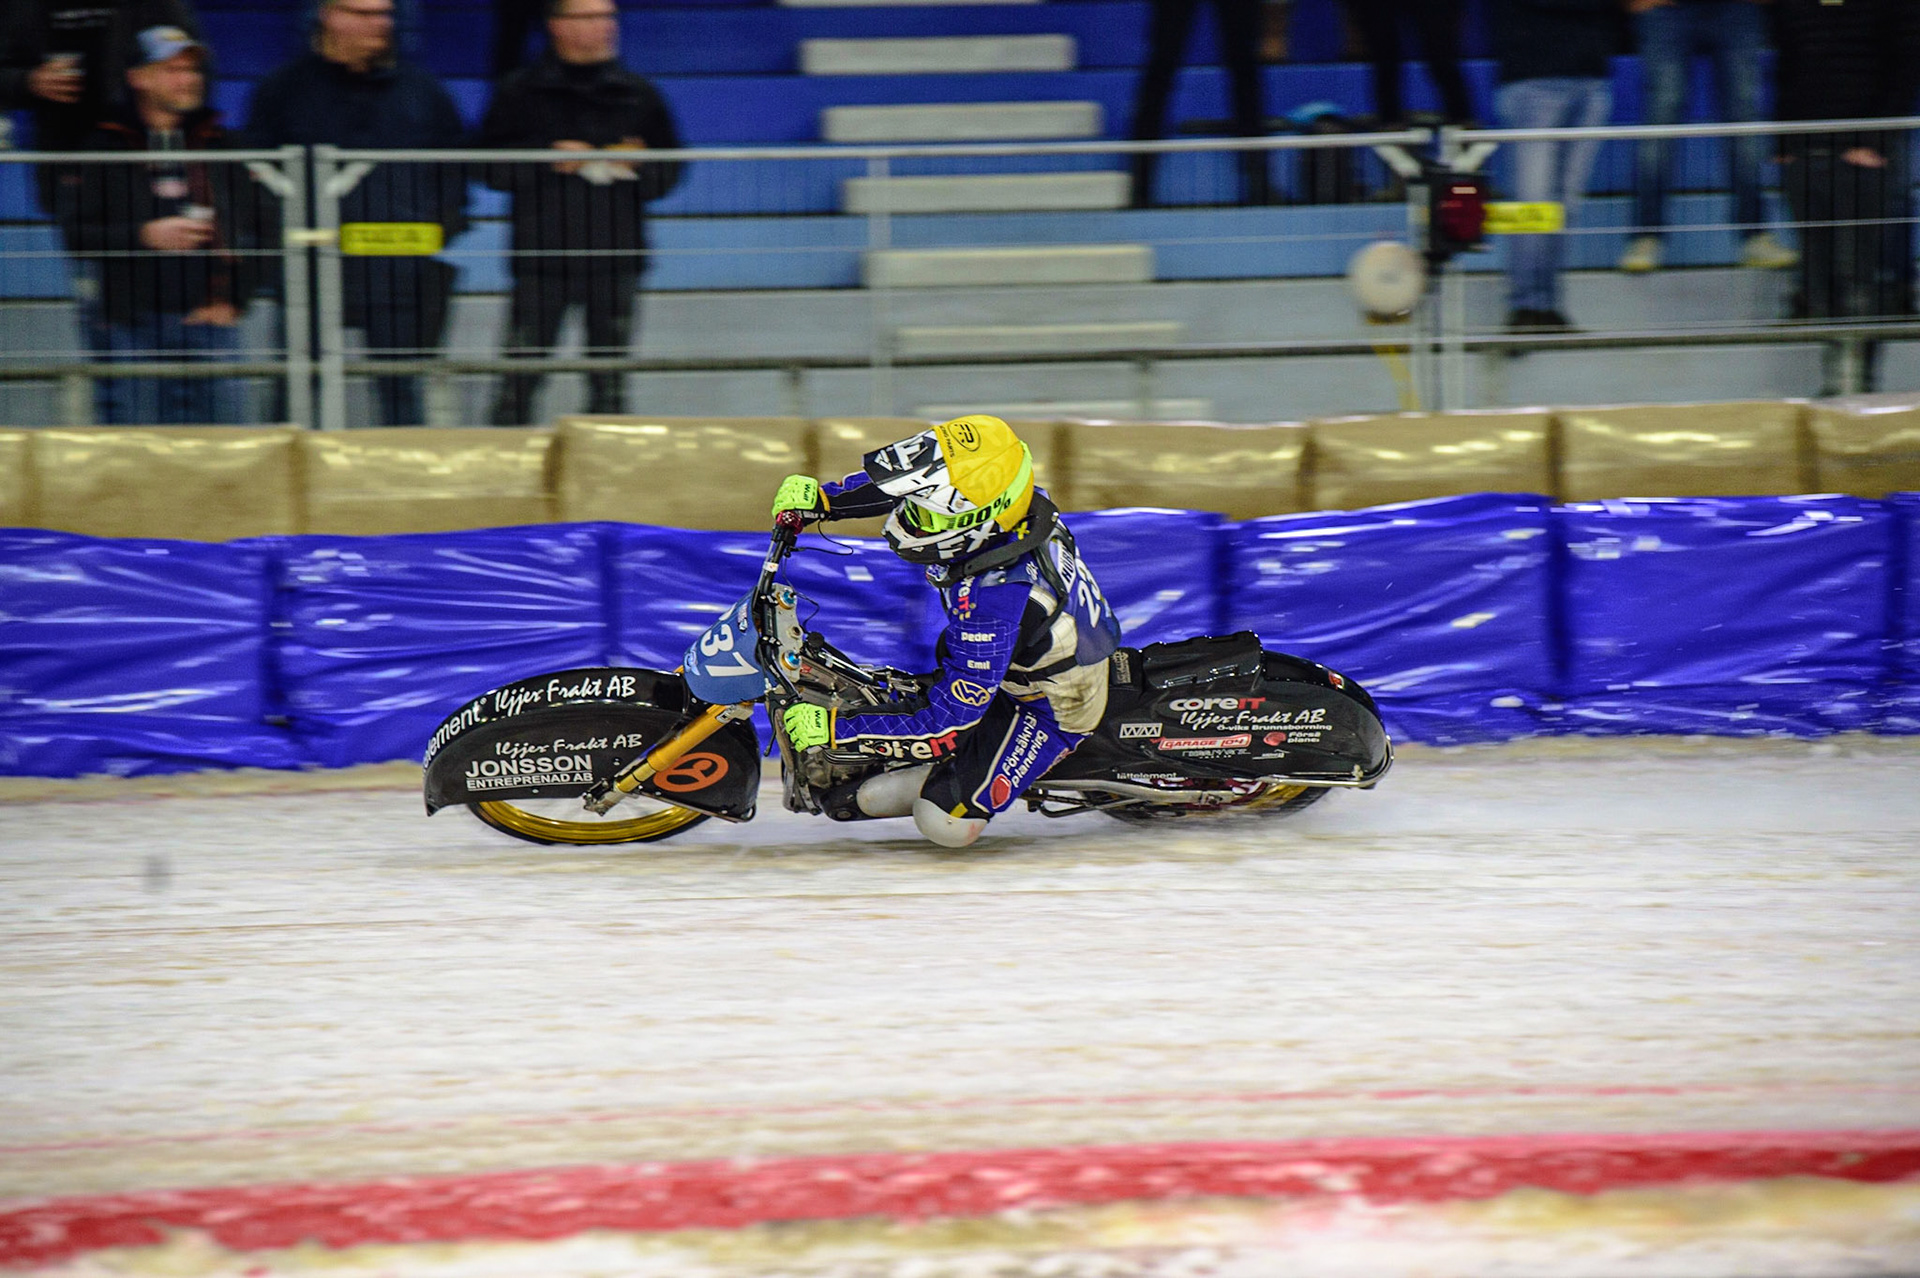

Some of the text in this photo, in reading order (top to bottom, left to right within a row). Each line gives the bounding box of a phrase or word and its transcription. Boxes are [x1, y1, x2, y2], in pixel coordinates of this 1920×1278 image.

[961, 631, 997, 642] Peder
[967, 659, 991, 670] Emil
[547, 677, 602, 702] Frakt
[606, 675, 636, 698] AB
[1236, 711, 1292, 725] Frakt
[1294, 708, 1326, 724] AB
[553, 737, 608, 753] Frakt
[613, 734, 643, 749] AB
[1164, 737, 1245, 749] GARAGE 104
[464, 754, 593, 778] JONSSON
[1011, 730, 1049, 788] planering
[466, 772, 594, 789] ENTREPRENAD AB
